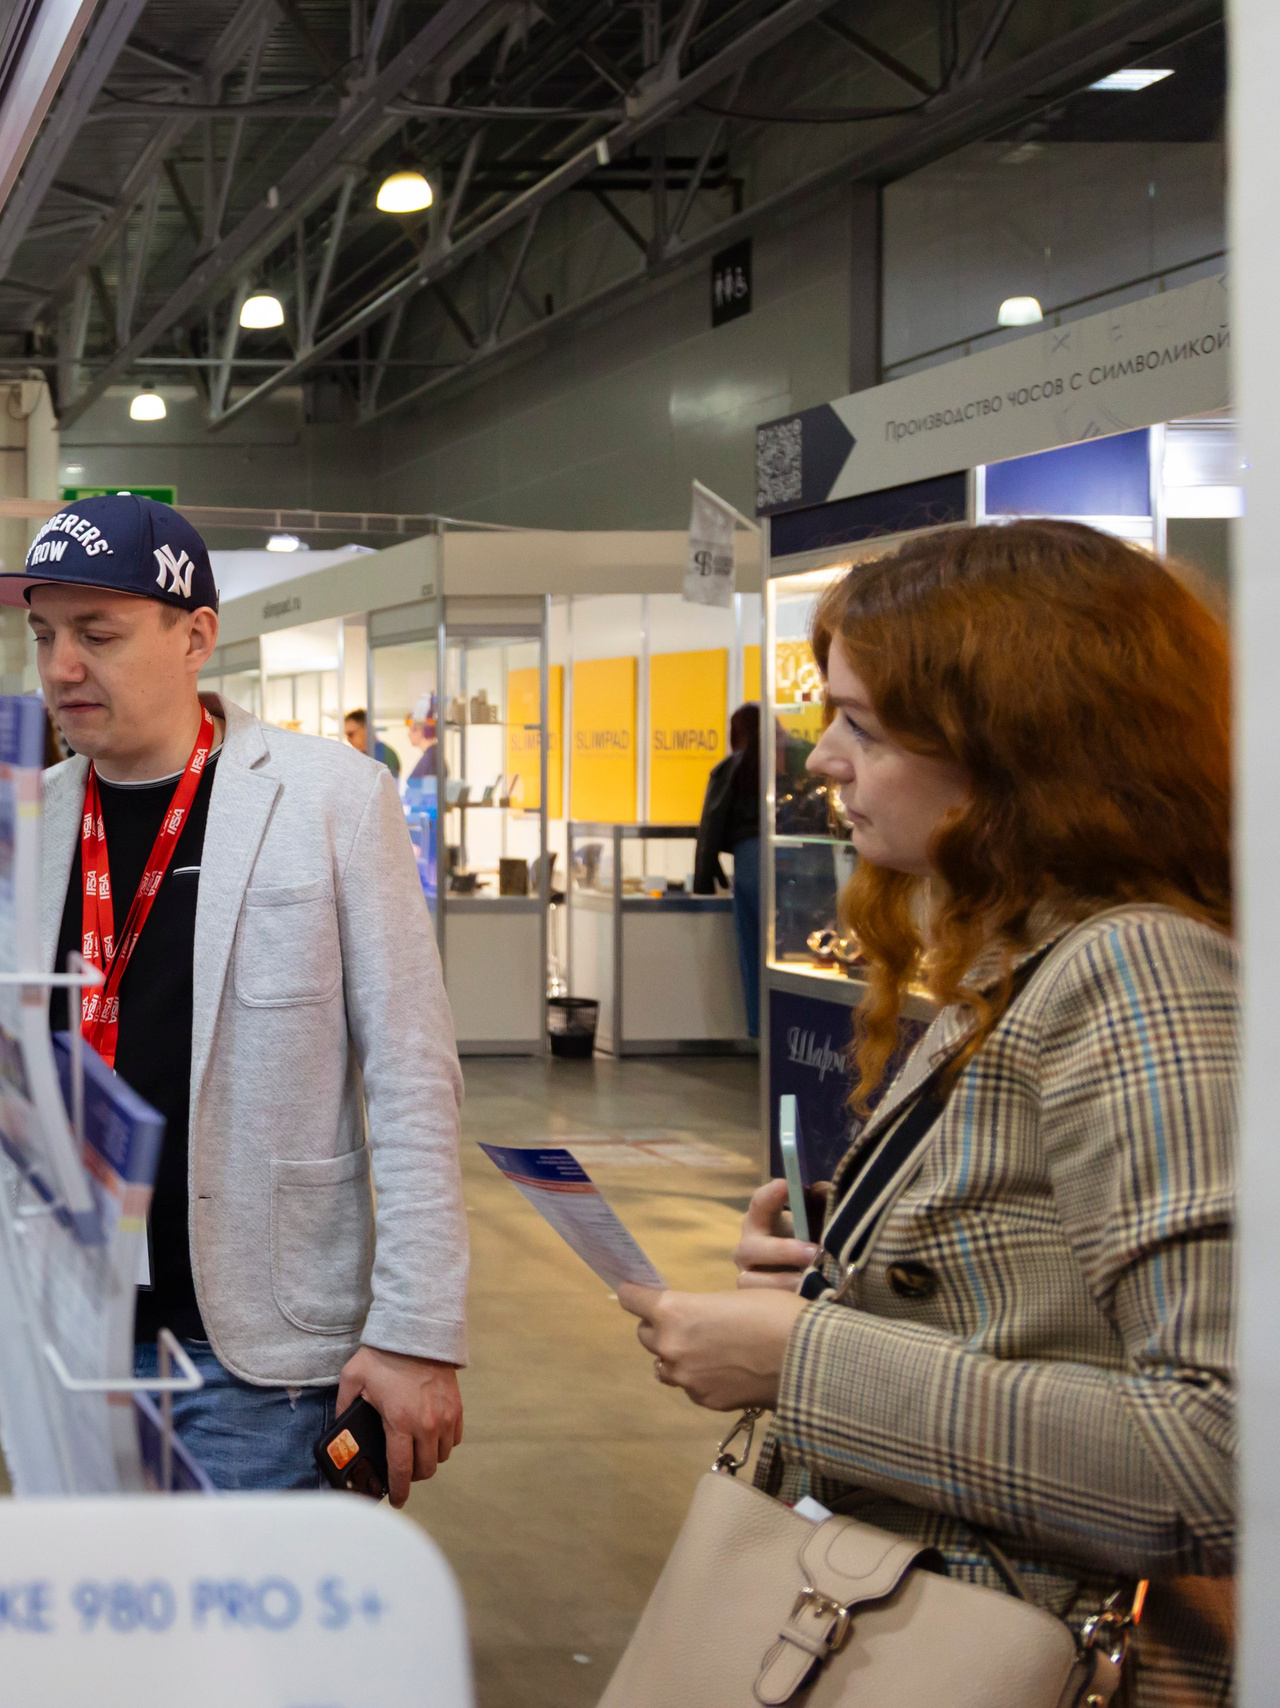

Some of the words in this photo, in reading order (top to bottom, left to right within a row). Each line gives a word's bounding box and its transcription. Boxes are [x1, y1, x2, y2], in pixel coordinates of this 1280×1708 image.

[31, 540, 69, 567] ROW
[153, 544, 195, 598] NY
[576, 729, 630, 750] SLIMPAD
[654, 729, 719, 751] SLIMPAD
[190, 748, 208, 774] IFSA
[167, 808, 185, 835] IFSA
[86, 870, 97, 896] IFSA
[99, 873, 110, 900] IFSA
[72, 1577, 178, 1633] 980
[191, 1575, 304, 1632] PRO
